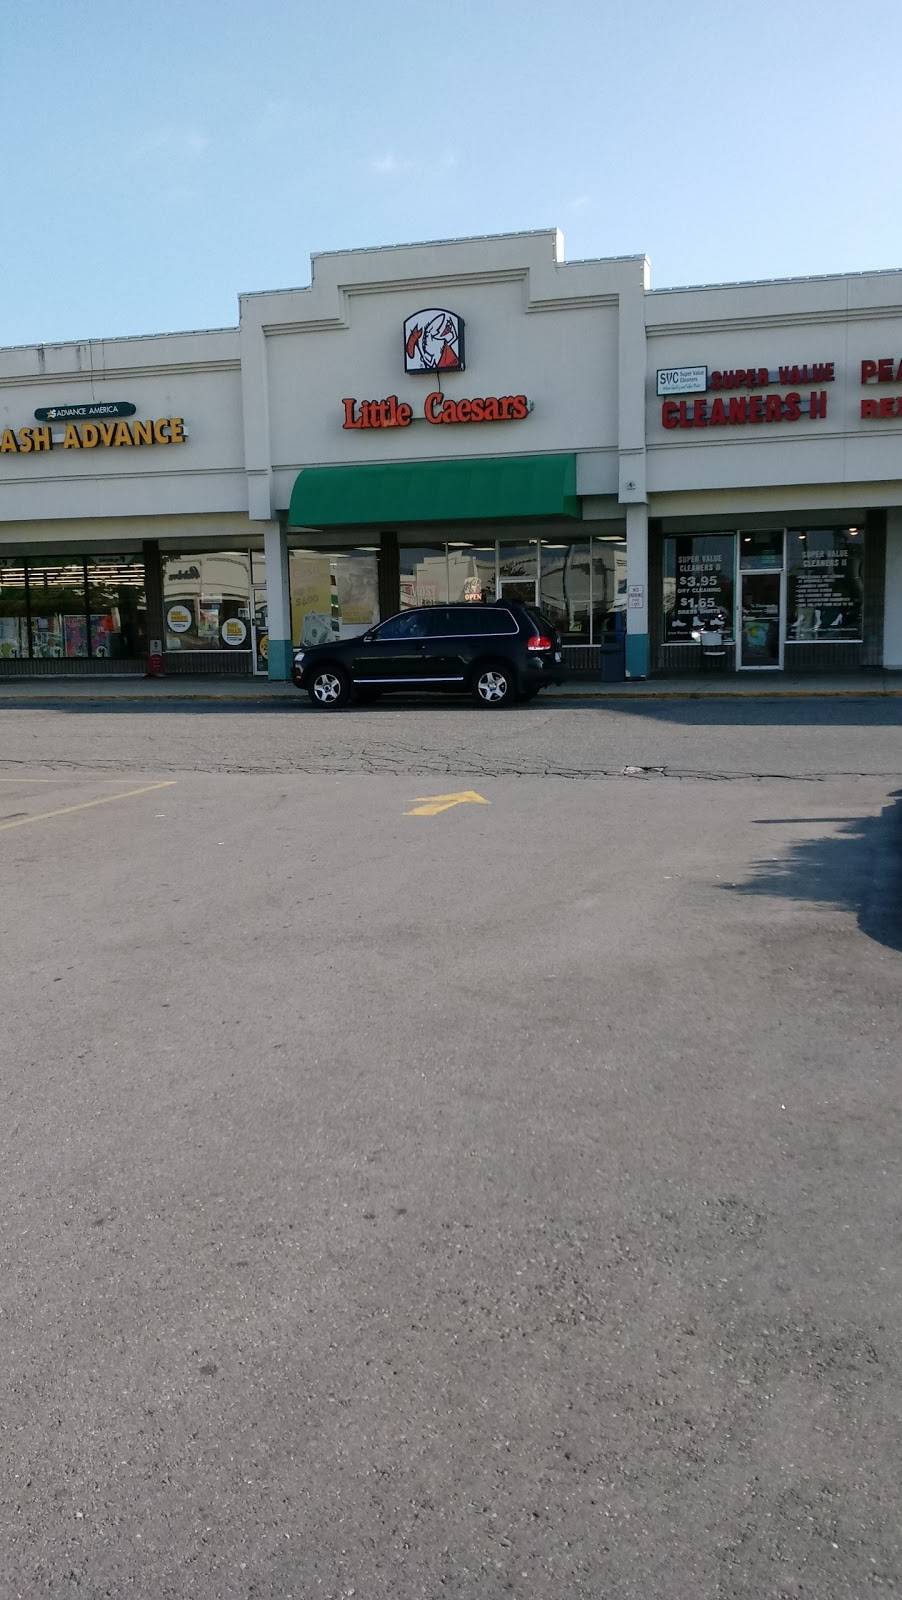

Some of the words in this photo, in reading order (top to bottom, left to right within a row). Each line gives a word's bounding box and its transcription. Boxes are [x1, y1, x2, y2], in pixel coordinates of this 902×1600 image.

[660, 371, 679, 385] SVC
[710, 367, 768, 390] SUPER
[57, 407, 86, 417] ADVANCE
[89, 406, 119, 415] AMERICA
[342, 395, 413, 429] Little
[424, 391, 528, 424] Caesars
[662, 392, 801, 429] CLEANERS
[809, 391, 827, 419] II
[63, 418, 185, 449] ADVANCE
[678, 555, 700, 564] SUPER
[702, 554, 722, 562] VALUE
[680, 564, 714, 572] CLEANERS
[679, 575, 717, 587] $3.95
[464, 592, 482, 601] OPEN
[680, 597, 715, 608] $1.65
